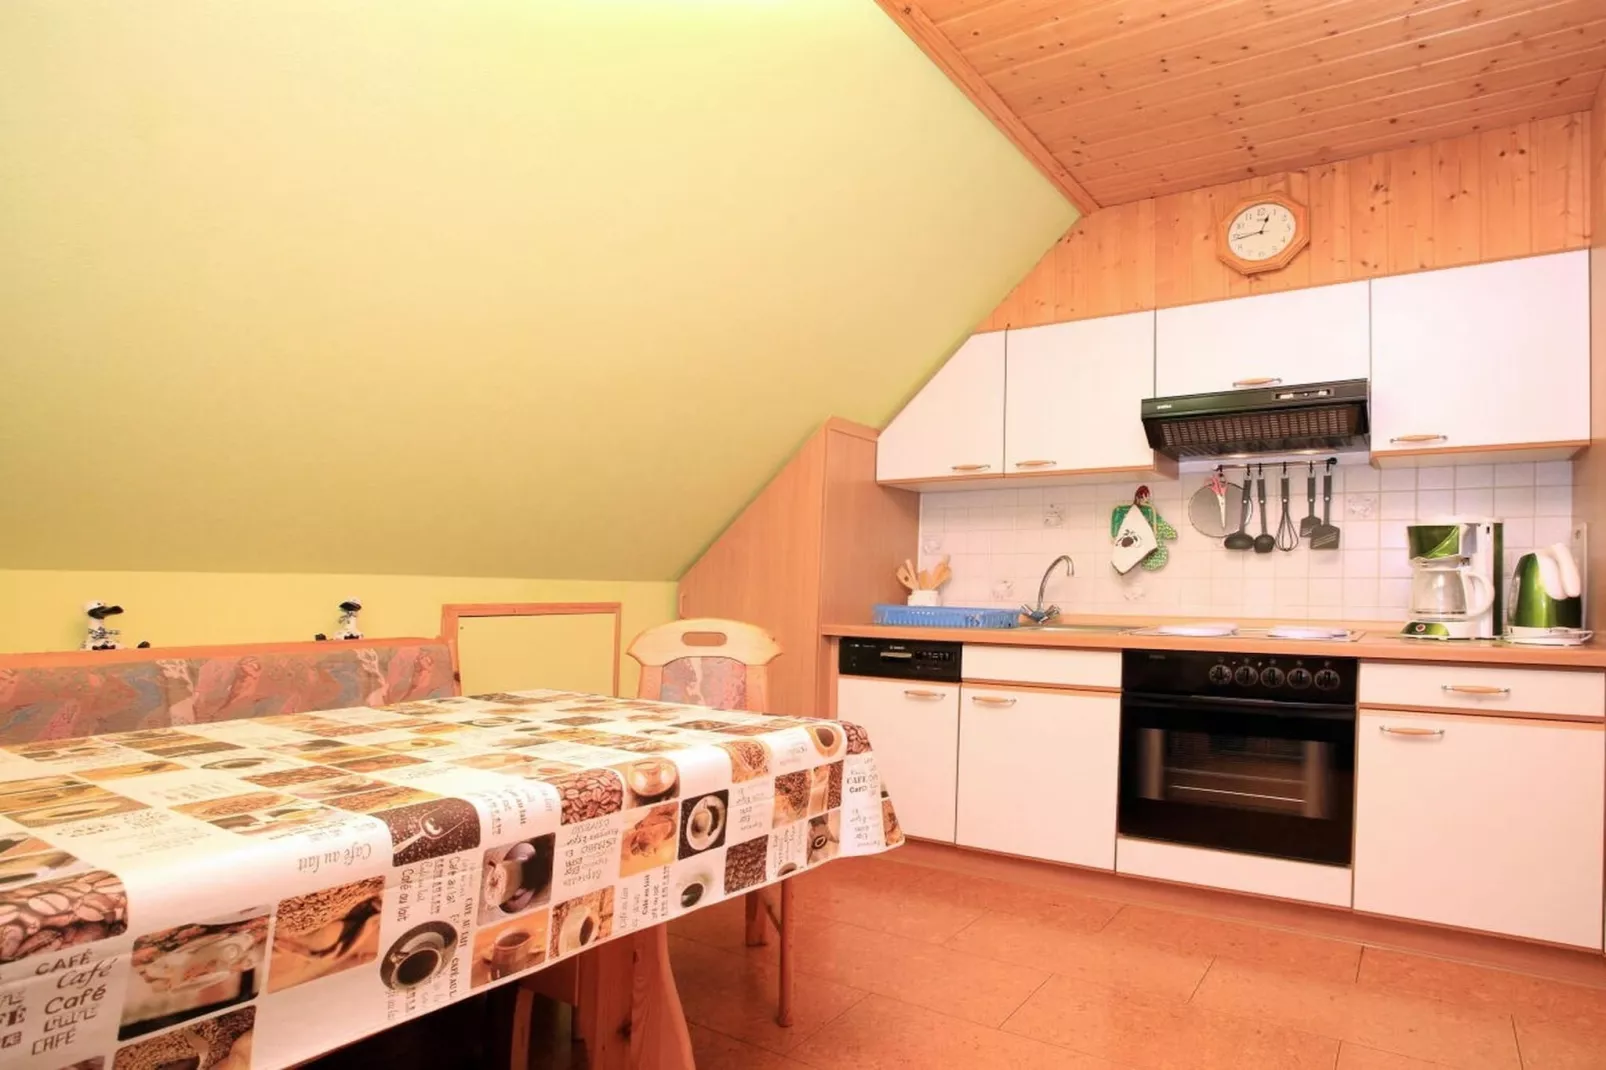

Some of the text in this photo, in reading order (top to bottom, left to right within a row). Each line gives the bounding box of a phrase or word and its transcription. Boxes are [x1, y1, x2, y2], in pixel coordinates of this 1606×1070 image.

[298, 842, 372, 874] Café au lait
[397, 868, 415, 922] Café au lait
[35, 948, 93, 975] CAFÉ
[56, 957, 119, 990] Café
[44, 984, 107, 1015] Café
